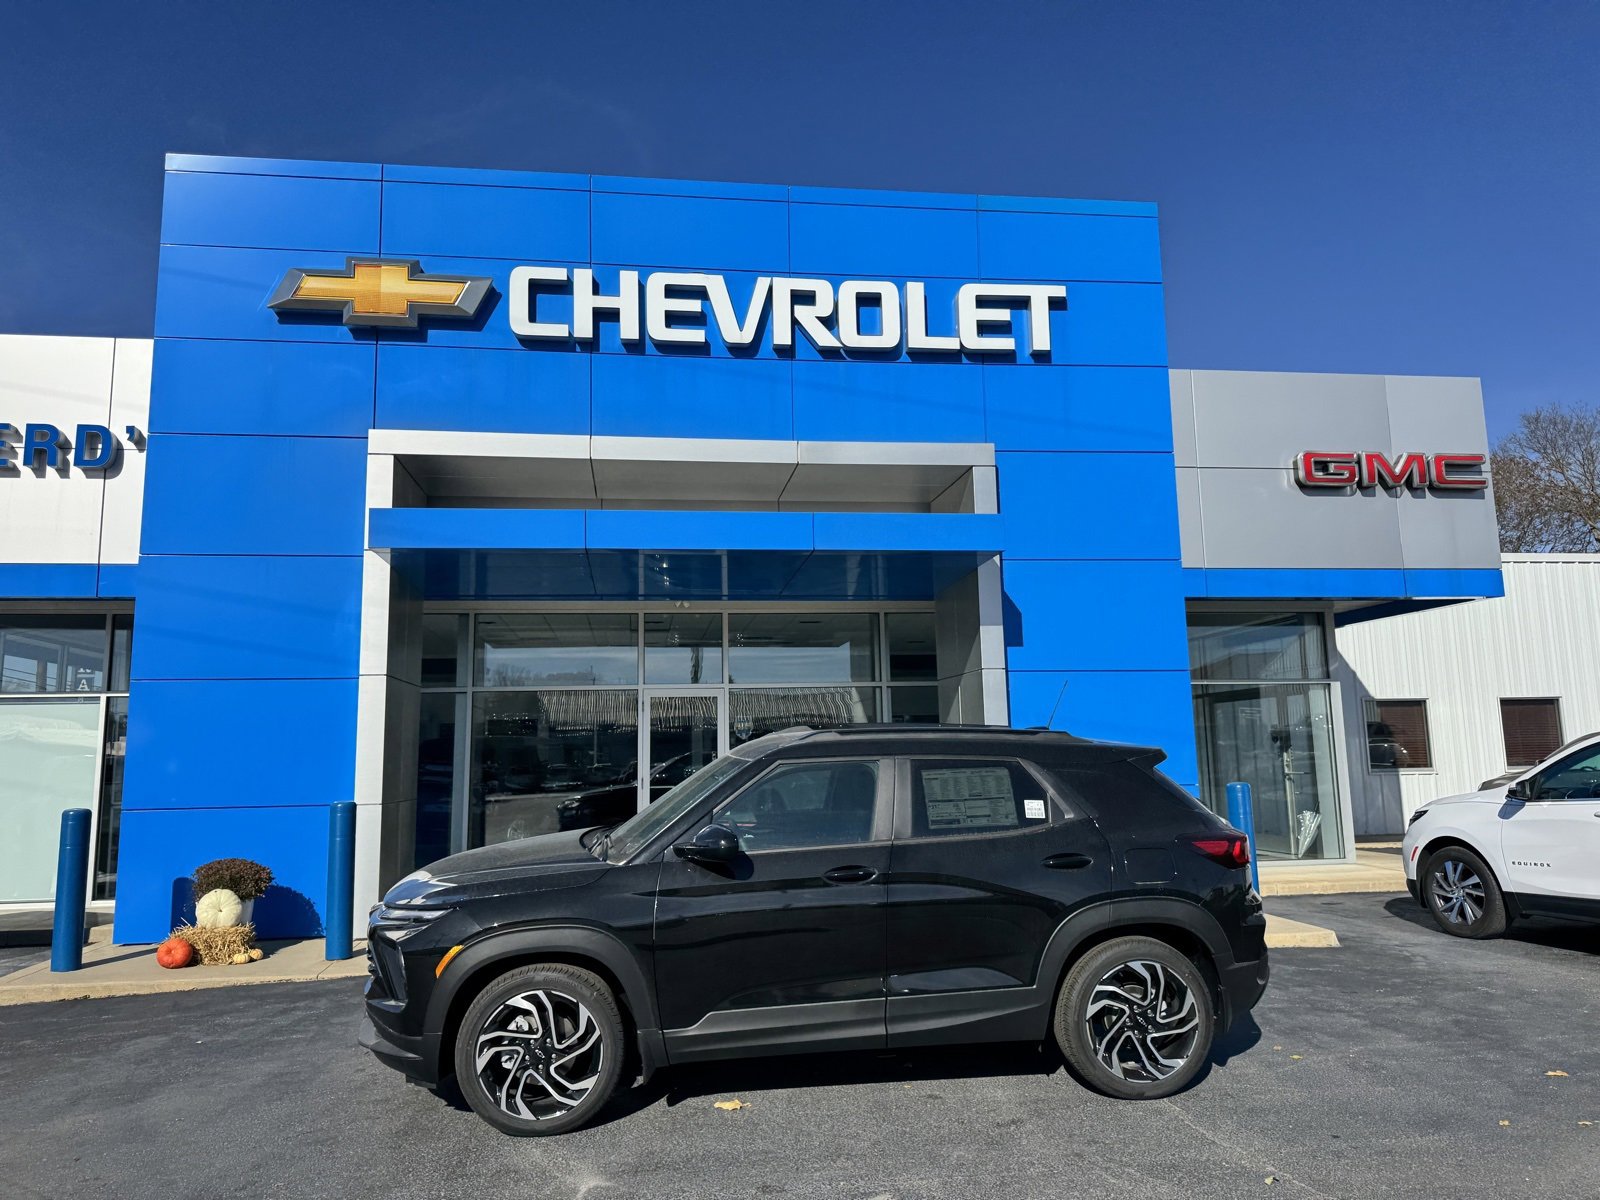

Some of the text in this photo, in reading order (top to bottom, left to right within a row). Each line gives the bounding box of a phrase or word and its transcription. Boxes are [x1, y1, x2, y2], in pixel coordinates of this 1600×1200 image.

[509, 266, 1067, 351] CHEVROLET
[0, 423, 137, 467] RD'
[1297, 450, 1489, 489] GMC
[1511, 860, 1551, 868] EQUINOX
